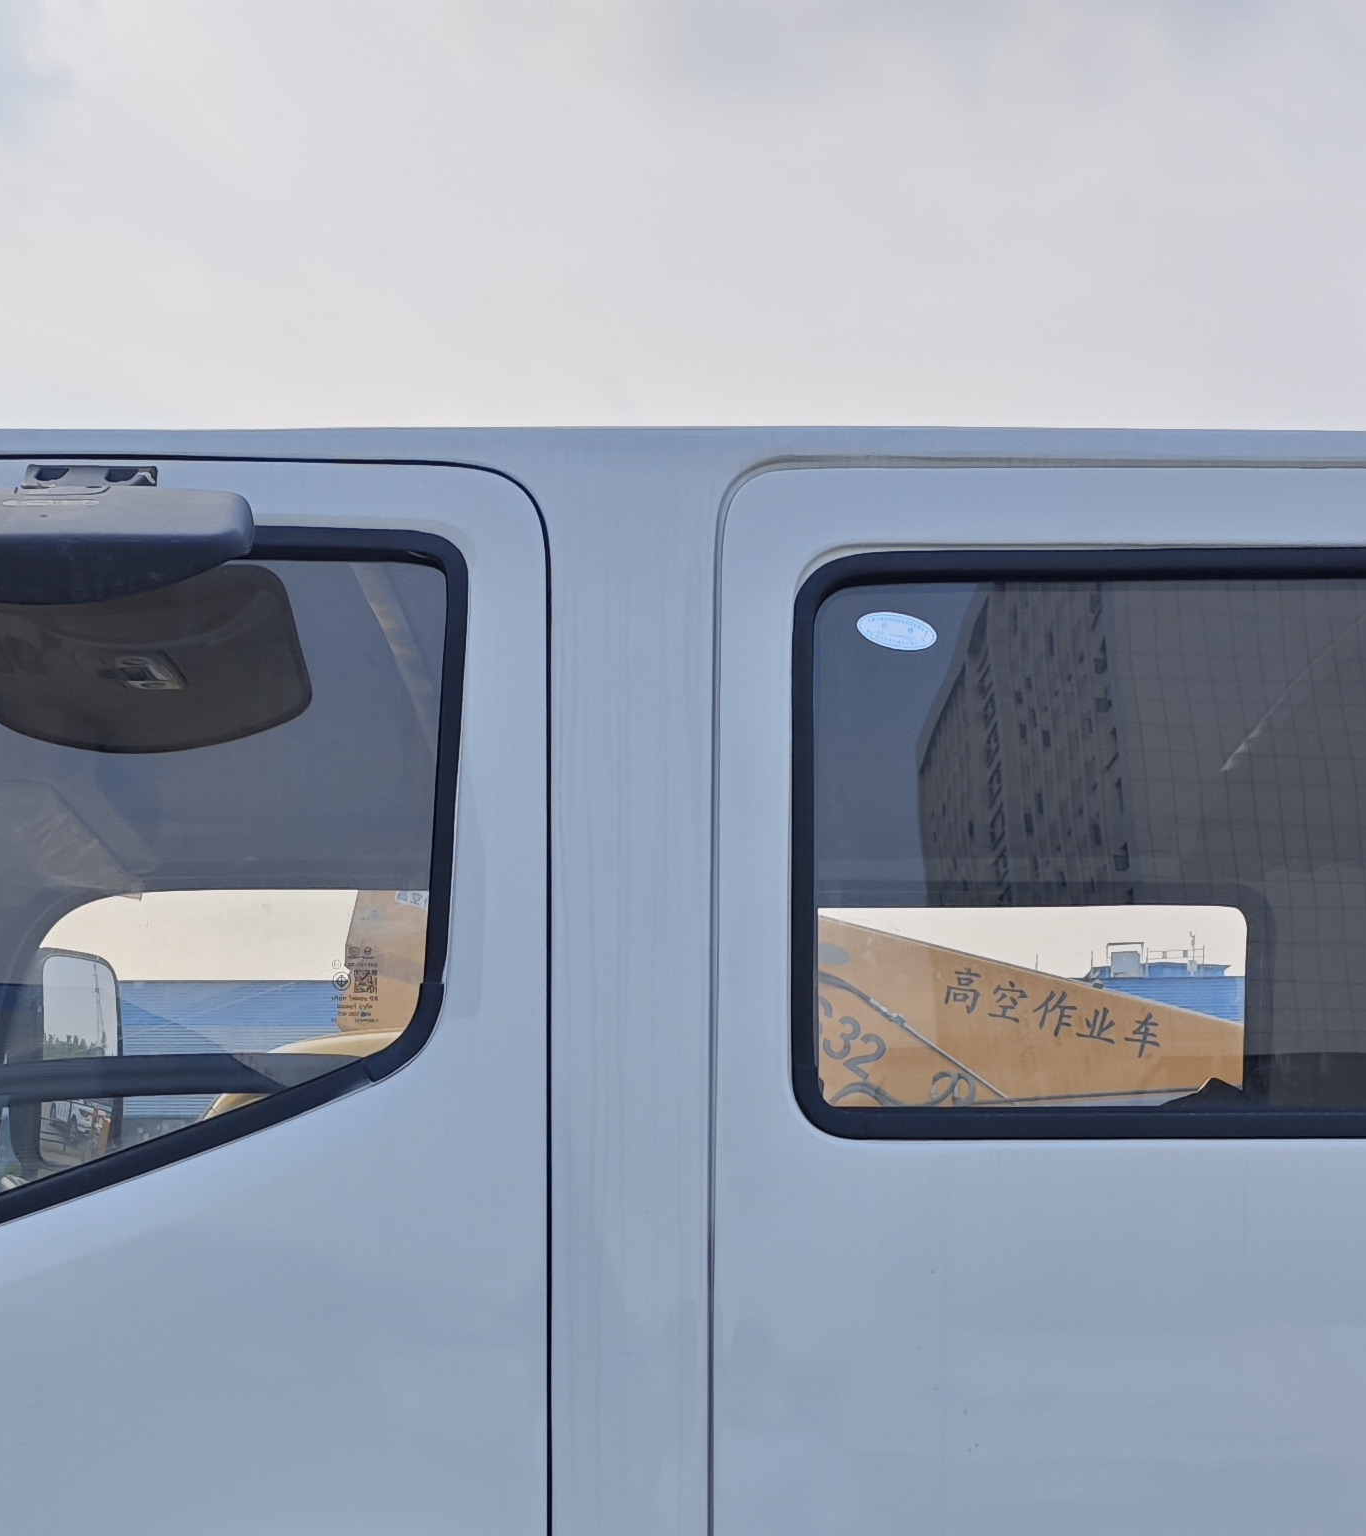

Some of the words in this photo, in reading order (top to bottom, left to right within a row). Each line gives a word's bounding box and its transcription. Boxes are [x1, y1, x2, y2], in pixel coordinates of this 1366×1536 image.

[944, 967, 1160, 1058] 高空作业车
